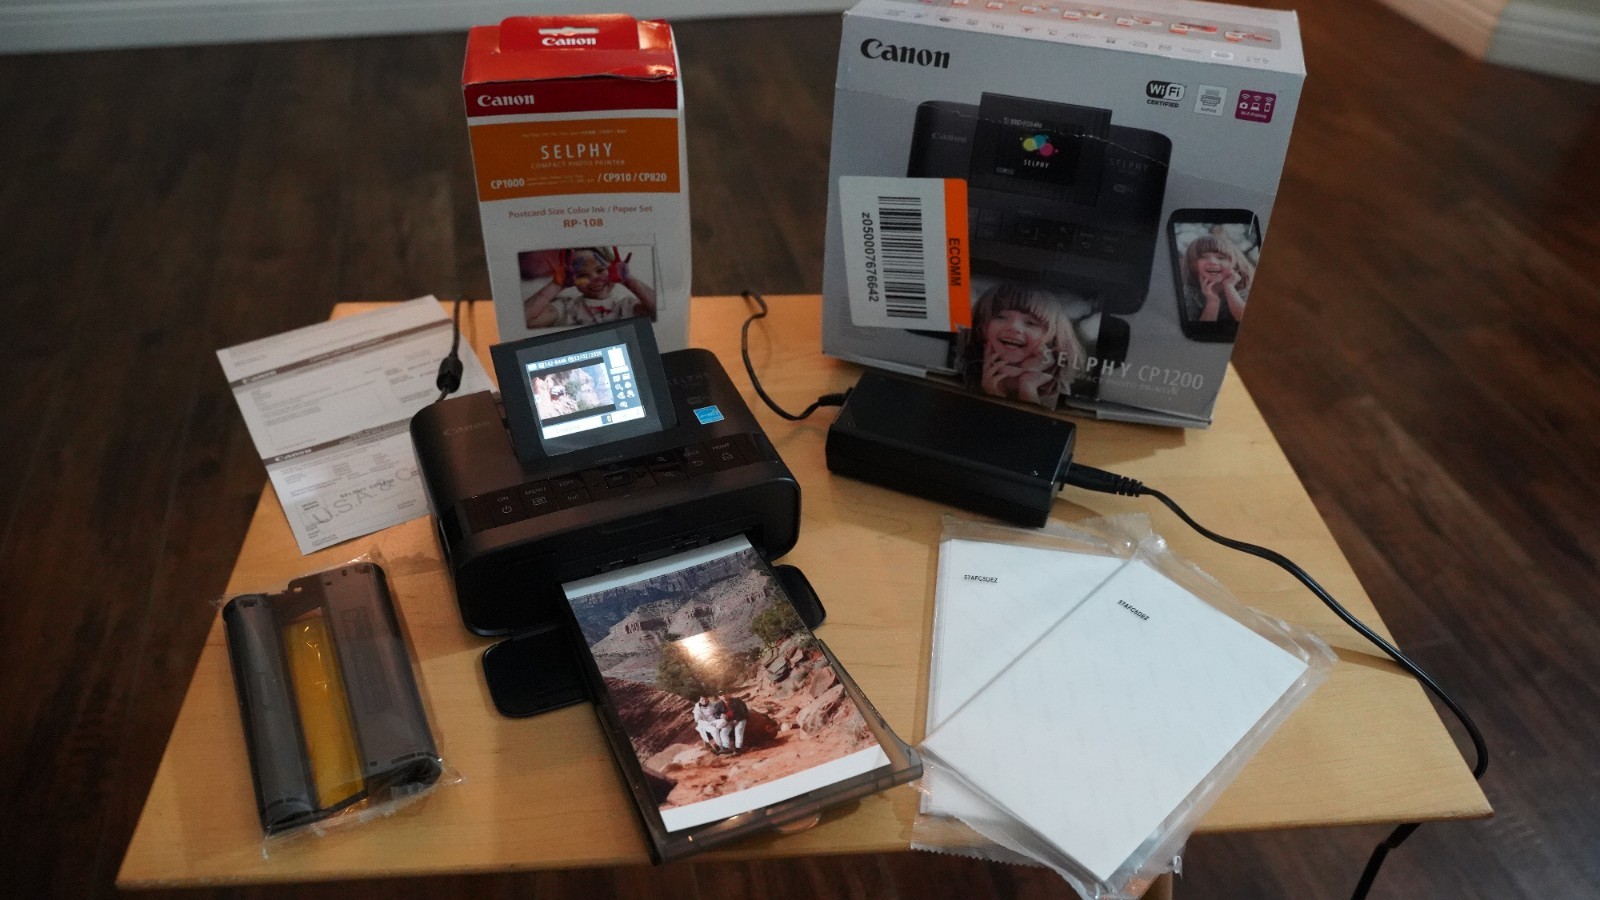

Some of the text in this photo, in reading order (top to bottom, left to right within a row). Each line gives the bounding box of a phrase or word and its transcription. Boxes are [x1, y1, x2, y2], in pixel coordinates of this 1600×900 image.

[541, 36, 597, 47] Canon
[860, 37, 951, 70] Canon
[476, 94, 535, 108] Canon
[1146, 98, 1179, 109] CERTIFIED
[931, 131, 967, 143] Canon
[540, 142, 613, 160] SELPHY
[530, 158, 625, 170] COMPACT PHOTO PRINTER
[1023, 158, 1050, 169] SELPHY
[490, 177, 525, 190] CP1000
[603, 172, 631, 184] CP910
[639, 171, 668, 182] CP820
[508, 208, 546, 219] Postcard
[547, 207, 565, 216] Size
[567, 206, 590, 215] Color
[592, 205, 605, 214] Ink
[613, 205, 637, 216] Paper
[639, 204, 653, 213] Set
[563, 217, 604, 228] RP-108
[861, 212, 879, 302] z050007676642
[948, 237, 962, 287] ECOMM
[1042, 348, 1204, 391] SELPHY CP1200
[443, 420, 491, 436] Canon
[712, 442, 731, 452] PRINT
[524, 486, 546, 496] MENU
[497, 495, 509, 504] ON
